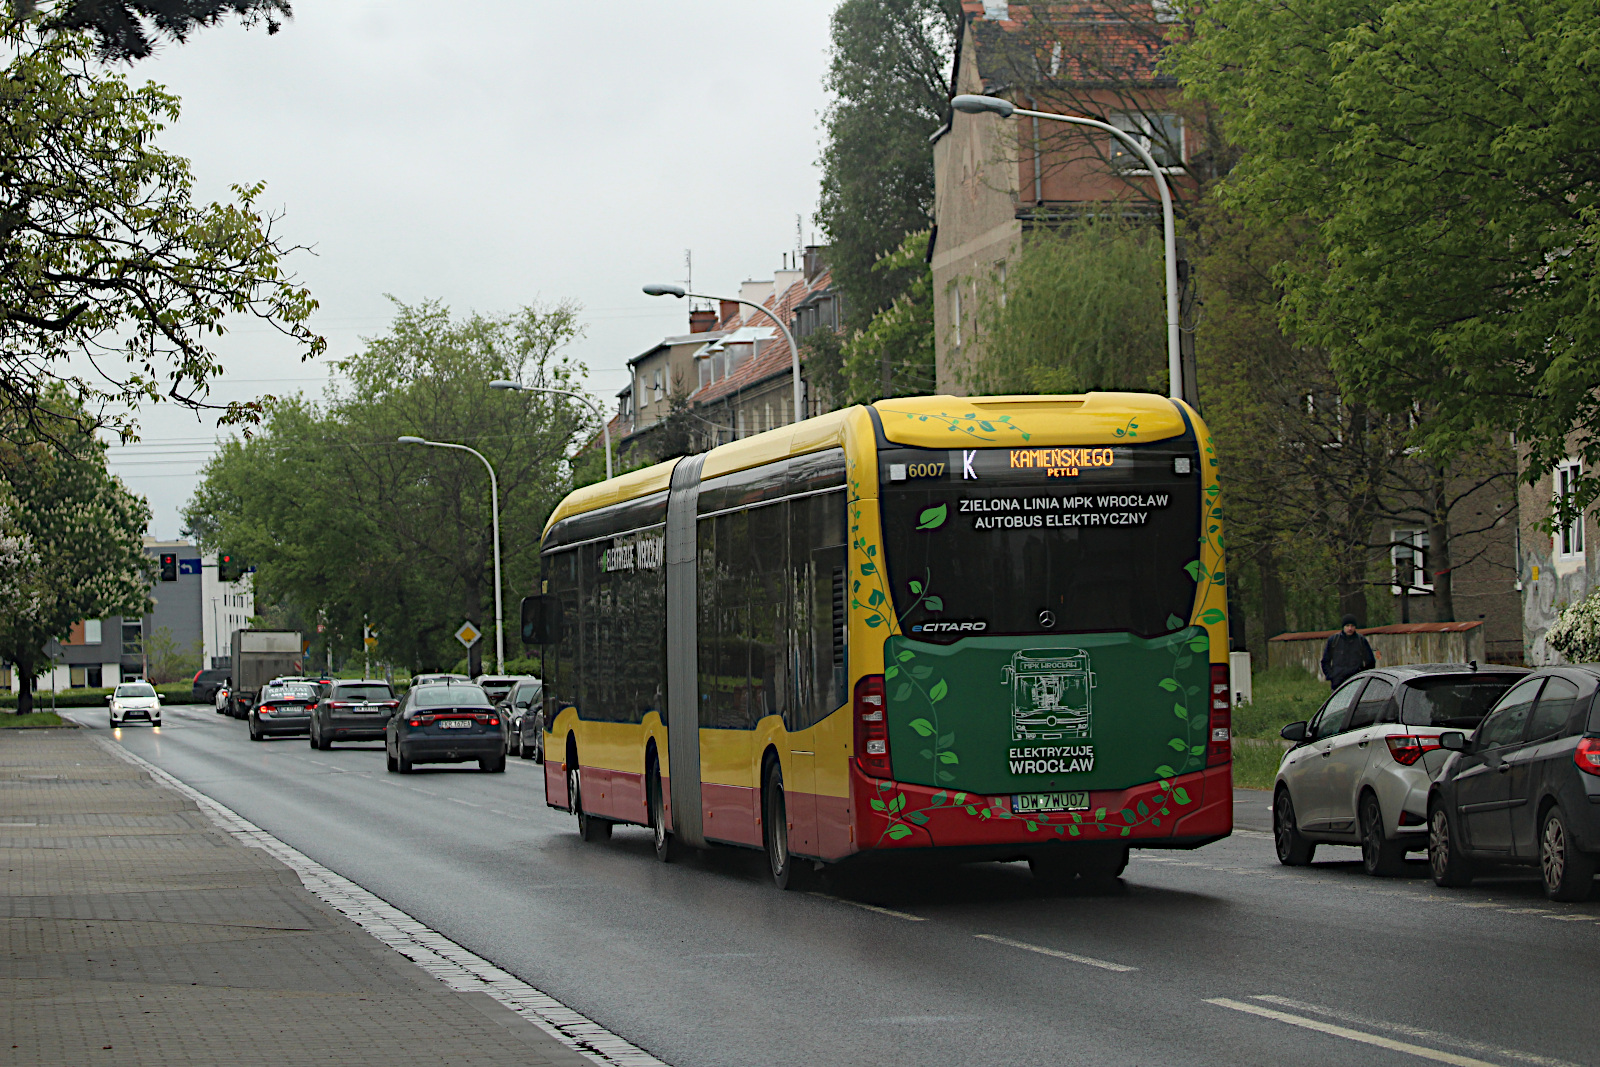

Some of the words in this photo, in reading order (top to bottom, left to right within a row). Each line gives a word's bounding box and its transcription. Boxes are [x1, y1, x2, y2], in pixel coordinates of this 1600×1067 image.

[963, 450, 978, 479] K
[1010, 448, 1114, 468] KAMIEŃSKIEGO
[908, 463, 945, 478] 6007
[1047, 467, 1079, 477] PĘTLA
[960, 498, 1021, 512] ZIELONA
[1023, 497, 1060, 510] LINIA
[1063, 496, 1093, 509] MPK
[1097, 494, 1168, 508] WROCŁAW
[975, 515, 1043, 529] AUTOBUS
[1046, 512, 1148, 527] ELEKTRYCZNY
[911, 622, 987, 632] eCITARO
[1009, 745, 1094, 758] ELEKTRYZUJĘ
[1009, 758, 1095, 774] WROCŁAW
[1021, 795, 1039, 809] DW
[1043, 792, 1085, 808] 7WU07
